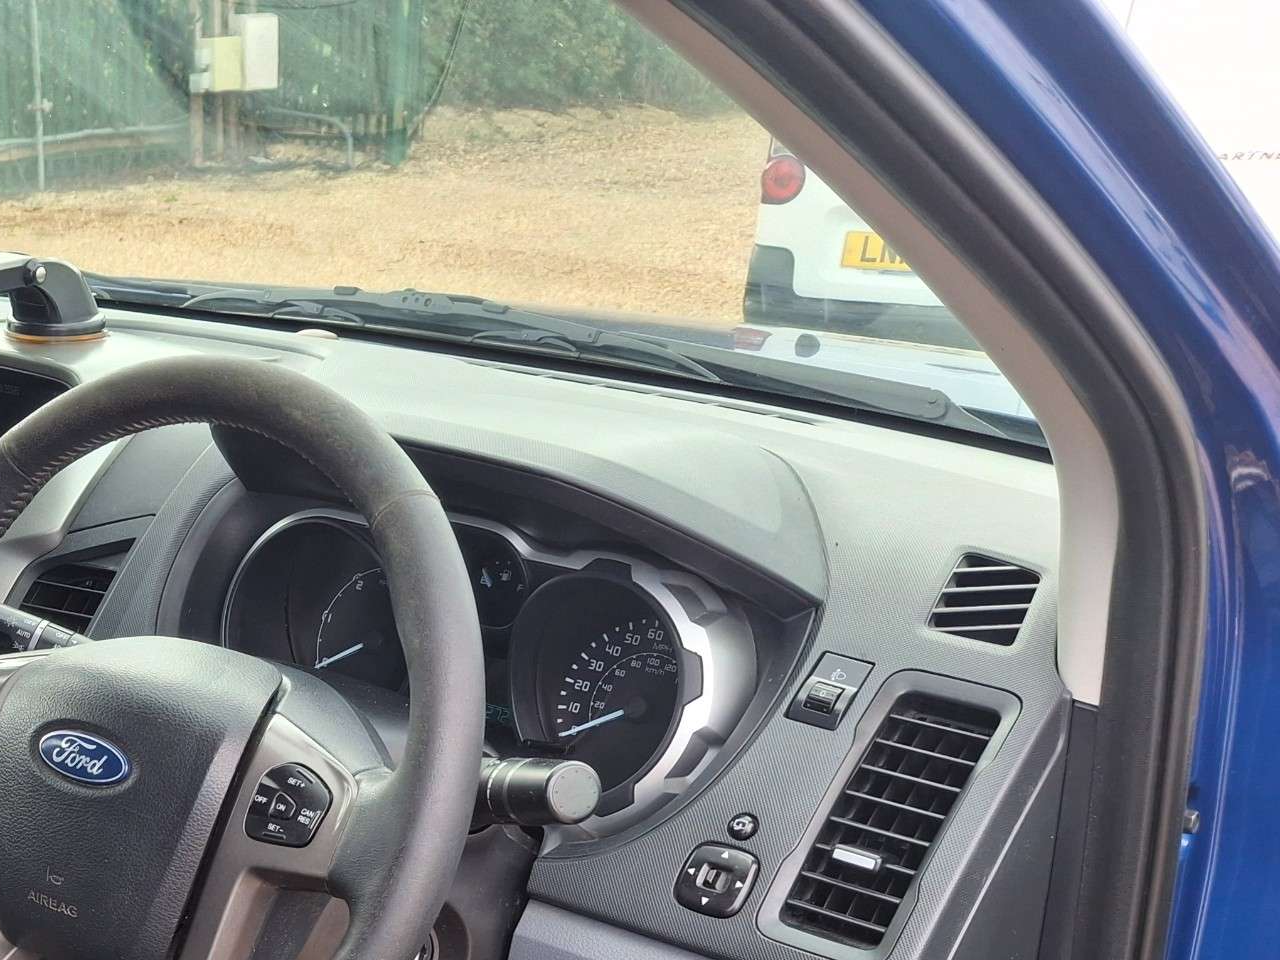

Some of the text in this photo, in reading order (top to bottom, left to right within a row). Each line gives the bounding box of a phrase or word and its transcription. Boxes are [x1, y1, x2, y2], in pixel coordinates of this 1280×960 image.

[355, 580, 364, 591] 2
[16, 629, 31, 639] AUTO
[624, 633, 641, 646] 50
[647, 628, 664, 641] 60
[605, 644, 622, 657] 40
[652, 642, 673, 653] MPH
[588, 659, 604, 672] 30
[630, 659, 642, 669] 80
[646, 657, 660, 666] 100
[614, 668, 626, 678] 60
[663, 664, 677, 673] 120
[574, 679, 591, 692] 20
[602, 683, 613, 692] 40
[568, 701, 581, 714] 10
[594, 700, 605, 710] 20
[52, 736, 108, 775] Ford
[287, 776, 306, 788] SET+
[254, 794, 269, 805] OFF
[275, 802, 287, 812] ON
[300, 807, 315, 818] CAN
[296, 815, 311, 826] RES
[27, 889, 79, 918] AIRBAG
